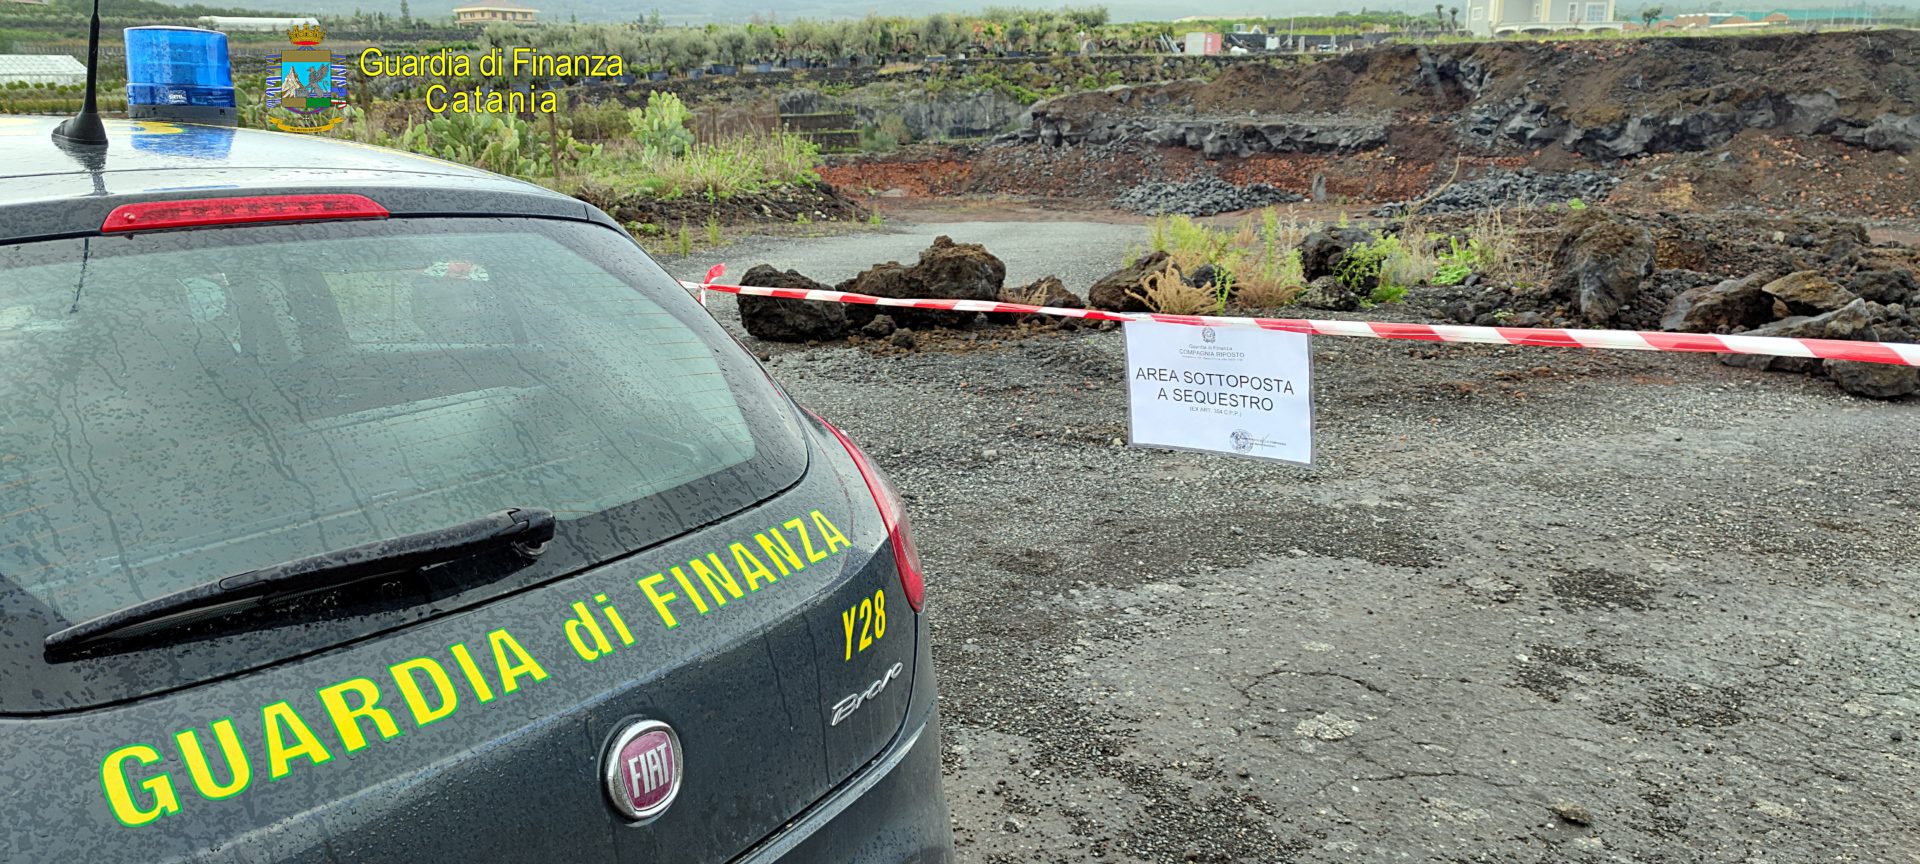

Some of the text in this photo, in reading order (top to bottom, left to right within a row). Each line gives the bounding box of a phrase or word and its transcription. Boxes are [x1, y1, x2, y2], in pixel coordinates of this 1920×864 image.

[1136, 367, 1295, 395] AREA SOTTOPOSTA
[1179, 349, 1215, 357] COMPAGNIA
[1157, 387, 1274, 411] A SEQUESTRO
[842, 588, 887, 662] Y28
[100, 509, 853, 828] GUARDIA di FINANZA
[830, 662, 904, 727] Bravo
[627, 742, 672, 798] FIAT
